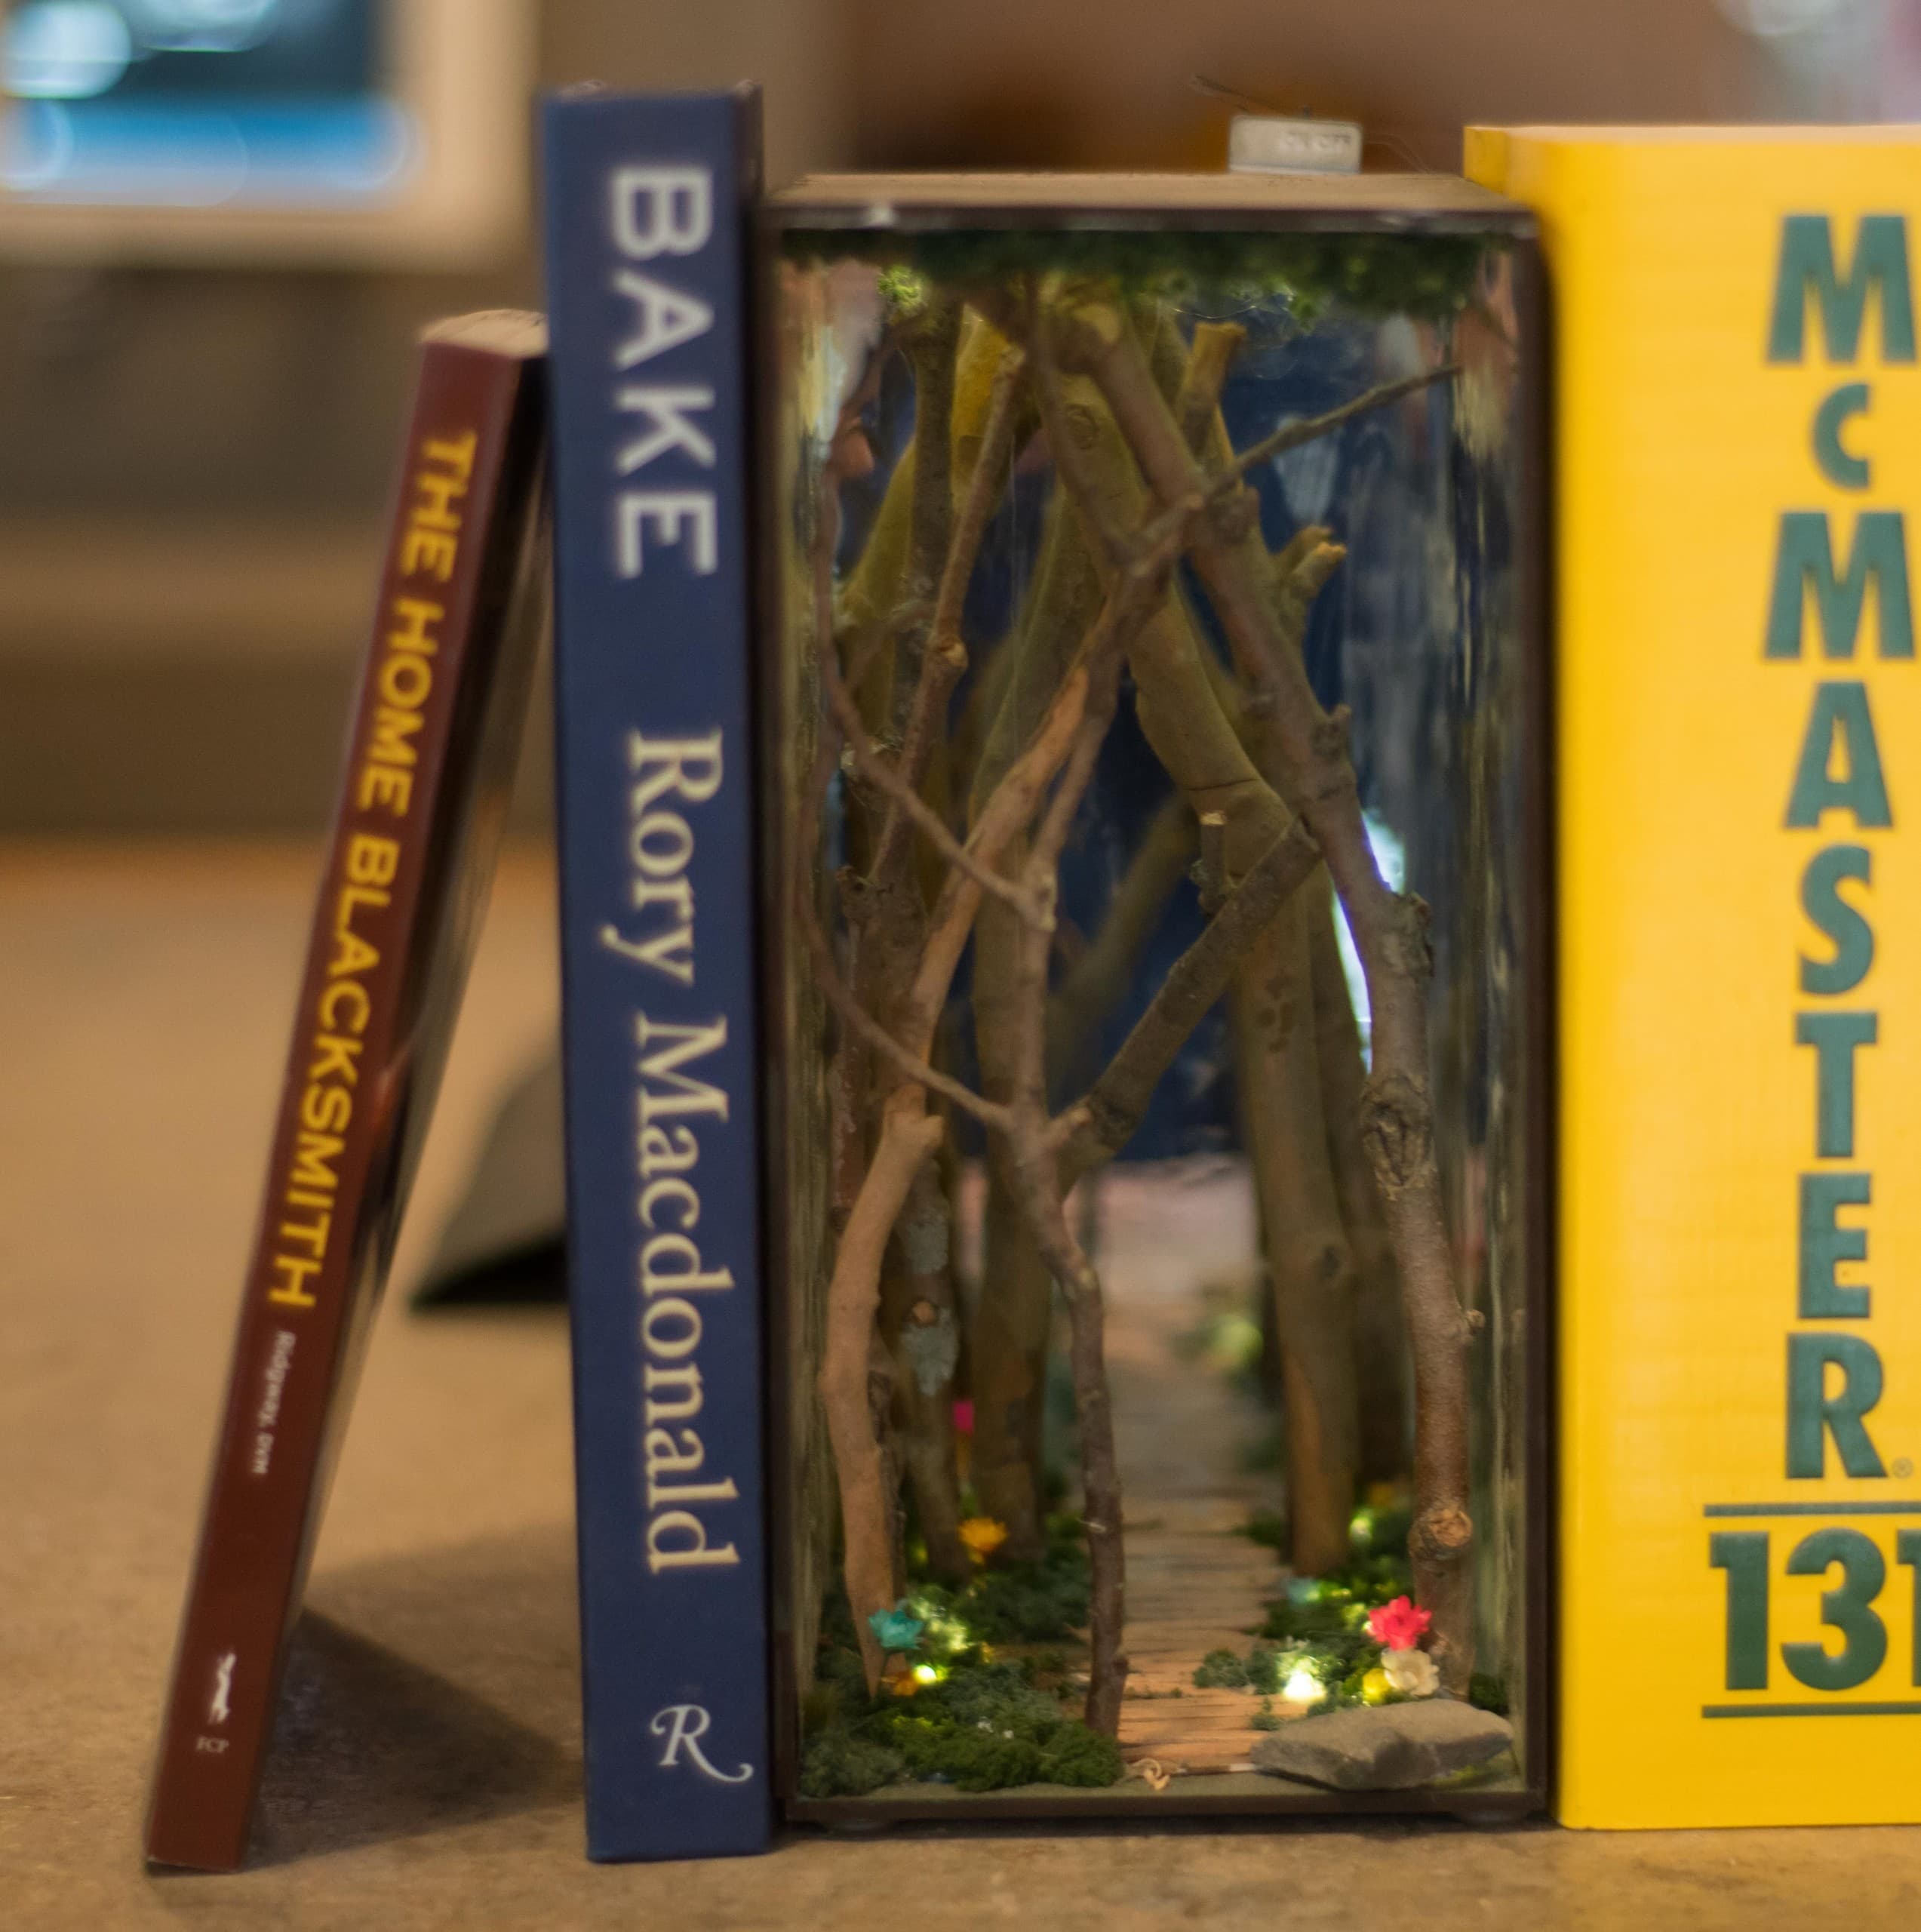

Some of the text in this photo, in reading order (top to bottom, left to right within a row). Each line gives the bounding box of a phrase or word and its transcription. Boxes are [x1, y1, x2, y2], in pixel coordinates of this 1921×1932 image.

[613, 165, 718, 579] BAKE
[268, 430, 477, 1309] THE HOME BLACKSMITH
[601, 728, 741, 1575] Rory Macdonald
